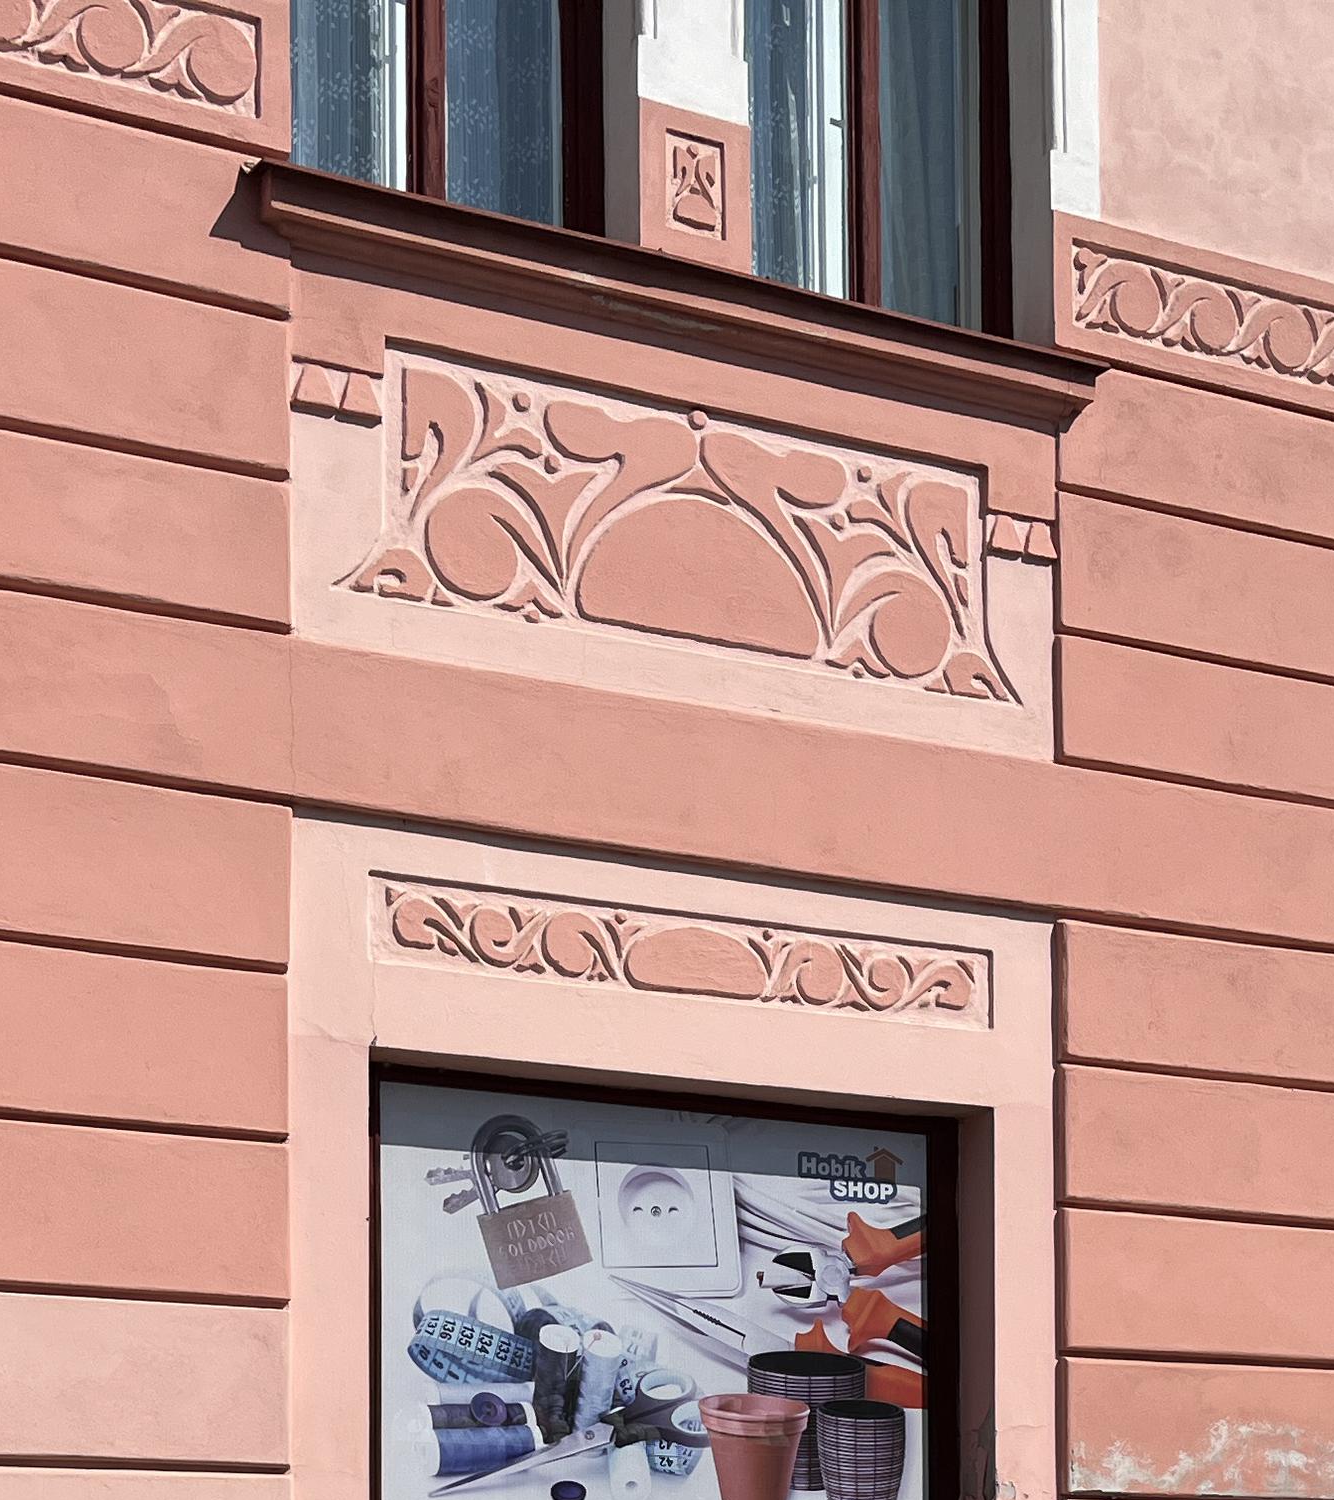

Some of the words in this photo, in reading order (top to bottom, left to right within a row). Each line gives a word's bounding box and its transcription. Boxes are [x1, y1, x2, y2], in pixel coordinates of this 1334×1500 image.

[801, 1156, 863, 1178] Hobík
[834, 1180, 894, 1200] SHOP
[439, 1320, 456, 1341] 136
[458, 1325, 475, 1348] 135
[476, 1331, 494, 1355] 134
[495, 1340, 511, 1362] 133
